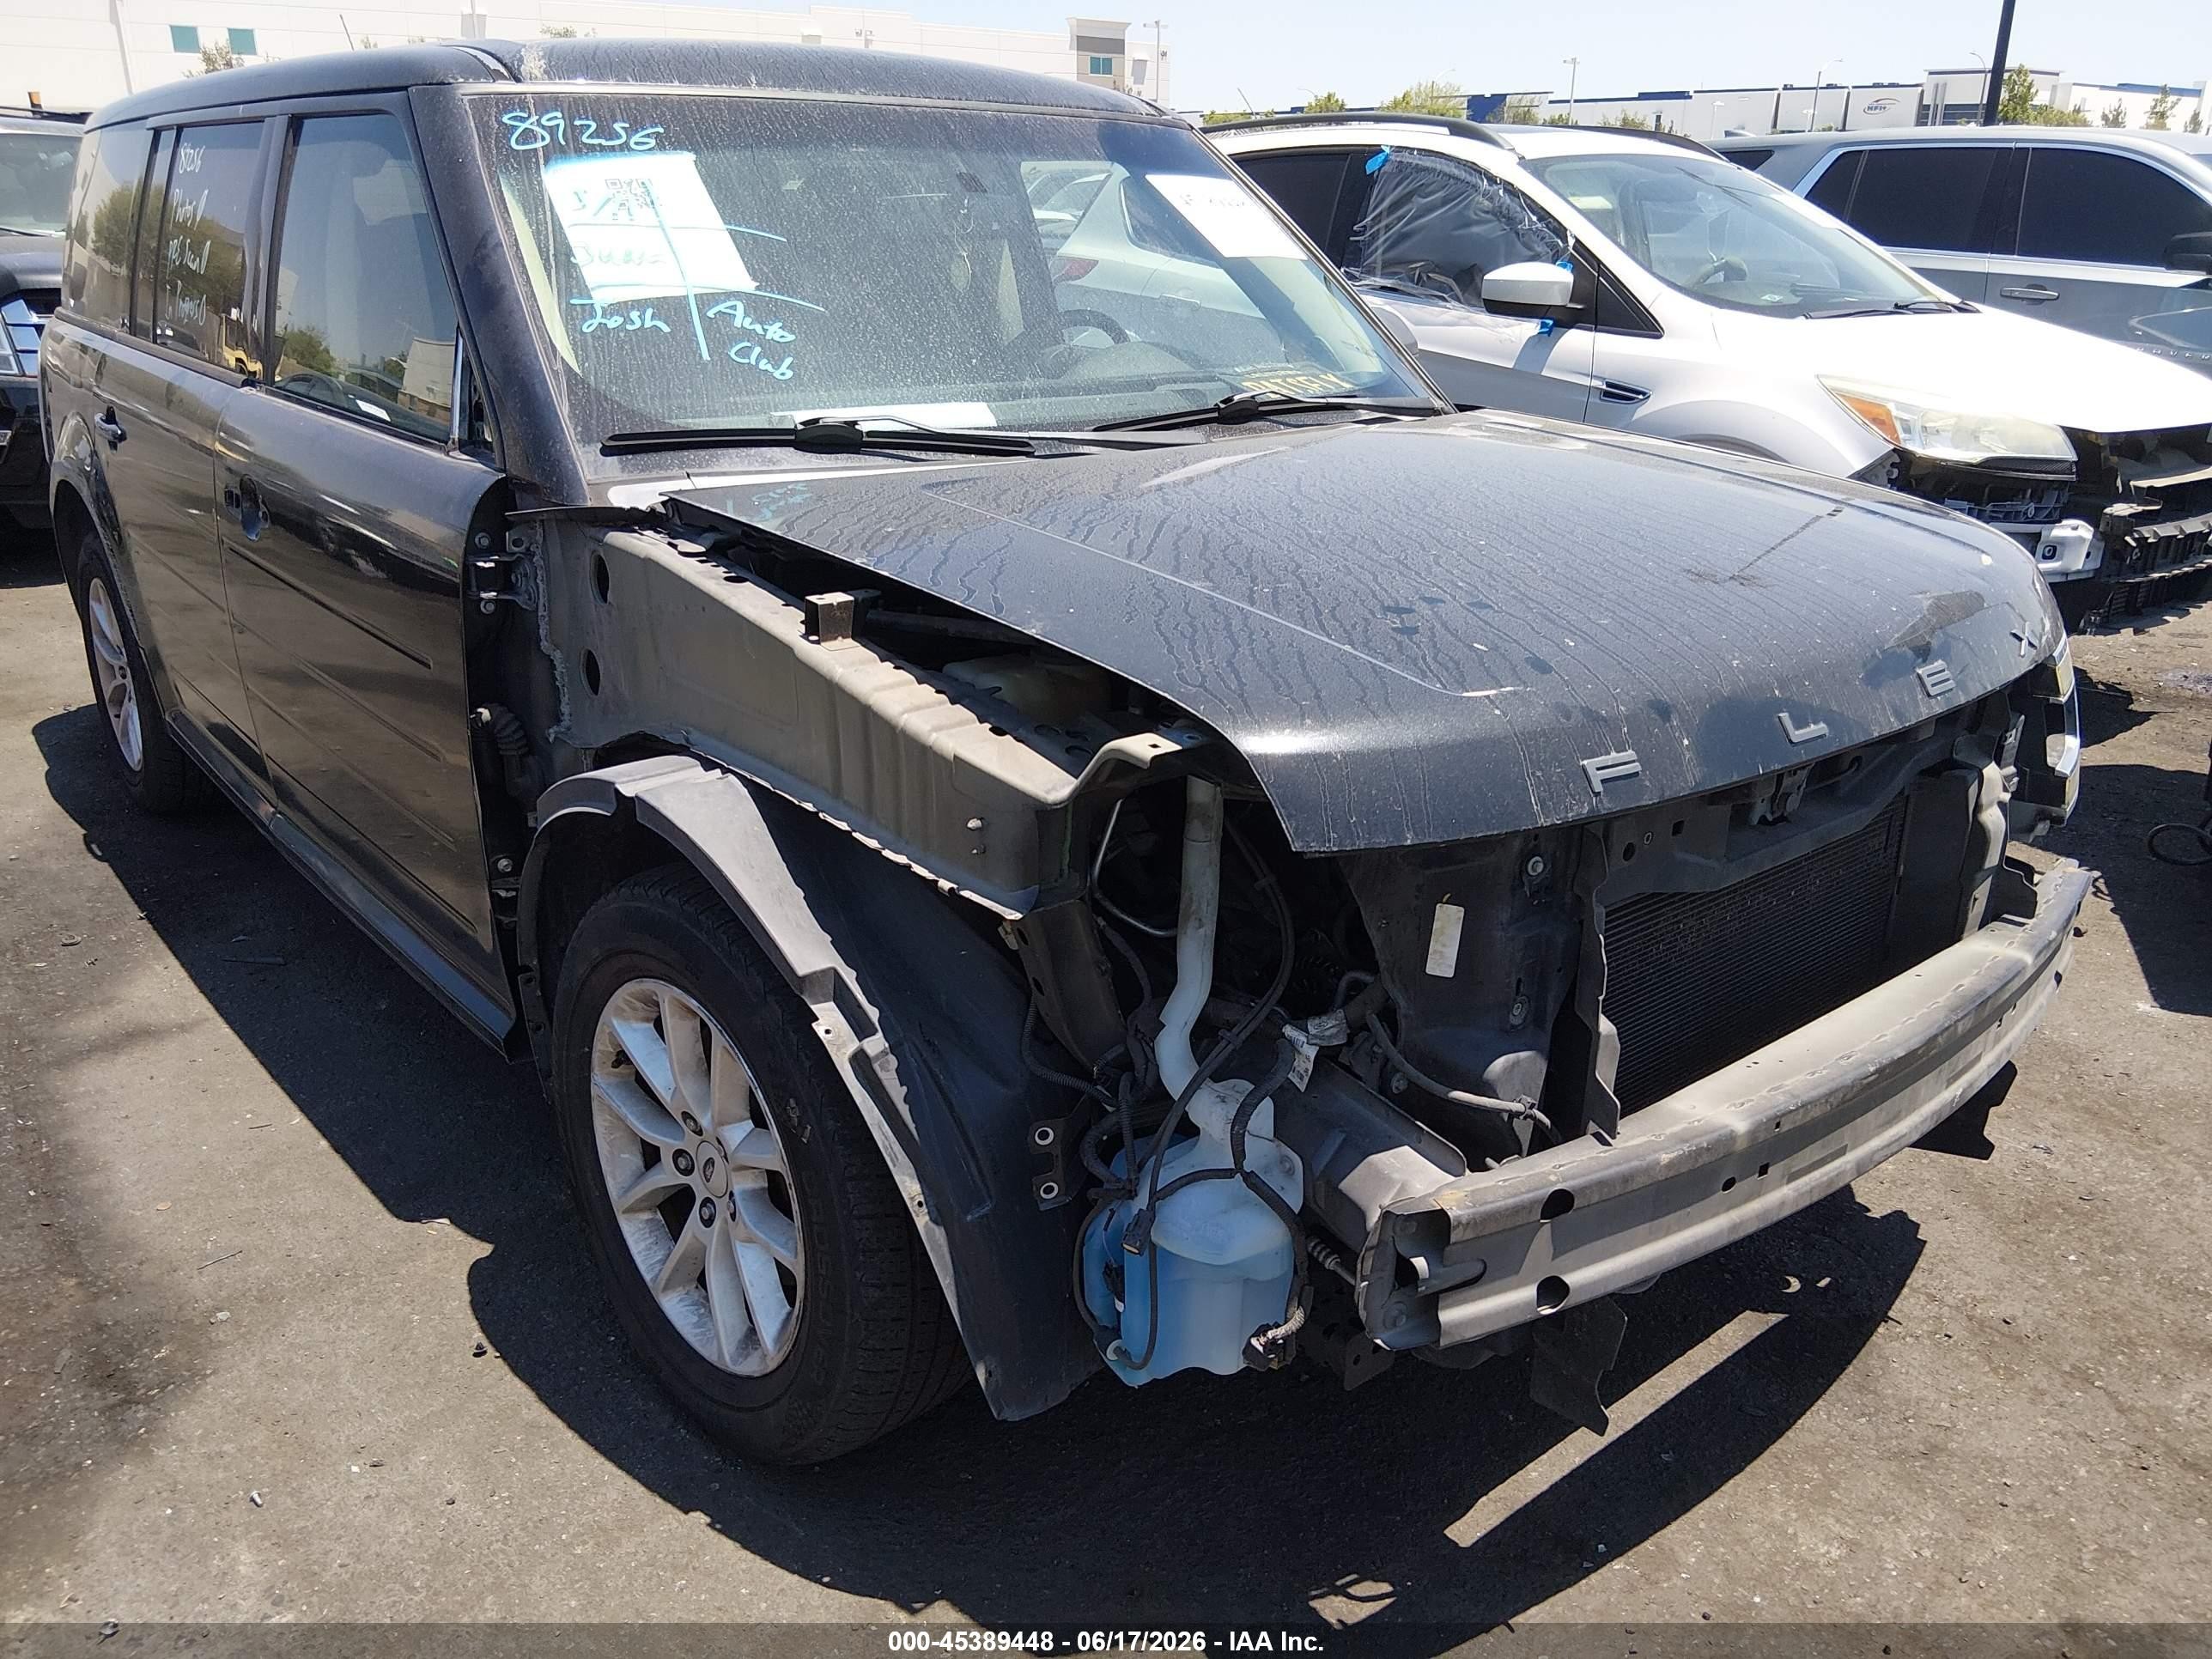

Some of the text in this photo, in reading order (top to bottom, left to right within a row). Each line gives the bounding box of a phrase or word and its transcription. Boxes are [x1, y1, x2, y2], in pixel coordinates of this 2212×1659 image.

[501, 111, 665, 150] 89256
[569, 298, 672, 333] Josh
[707, 301, 797, 343] Auto
[728, 342, 794, 380] Club
[1581, 622, 2037, 794] FLEX
